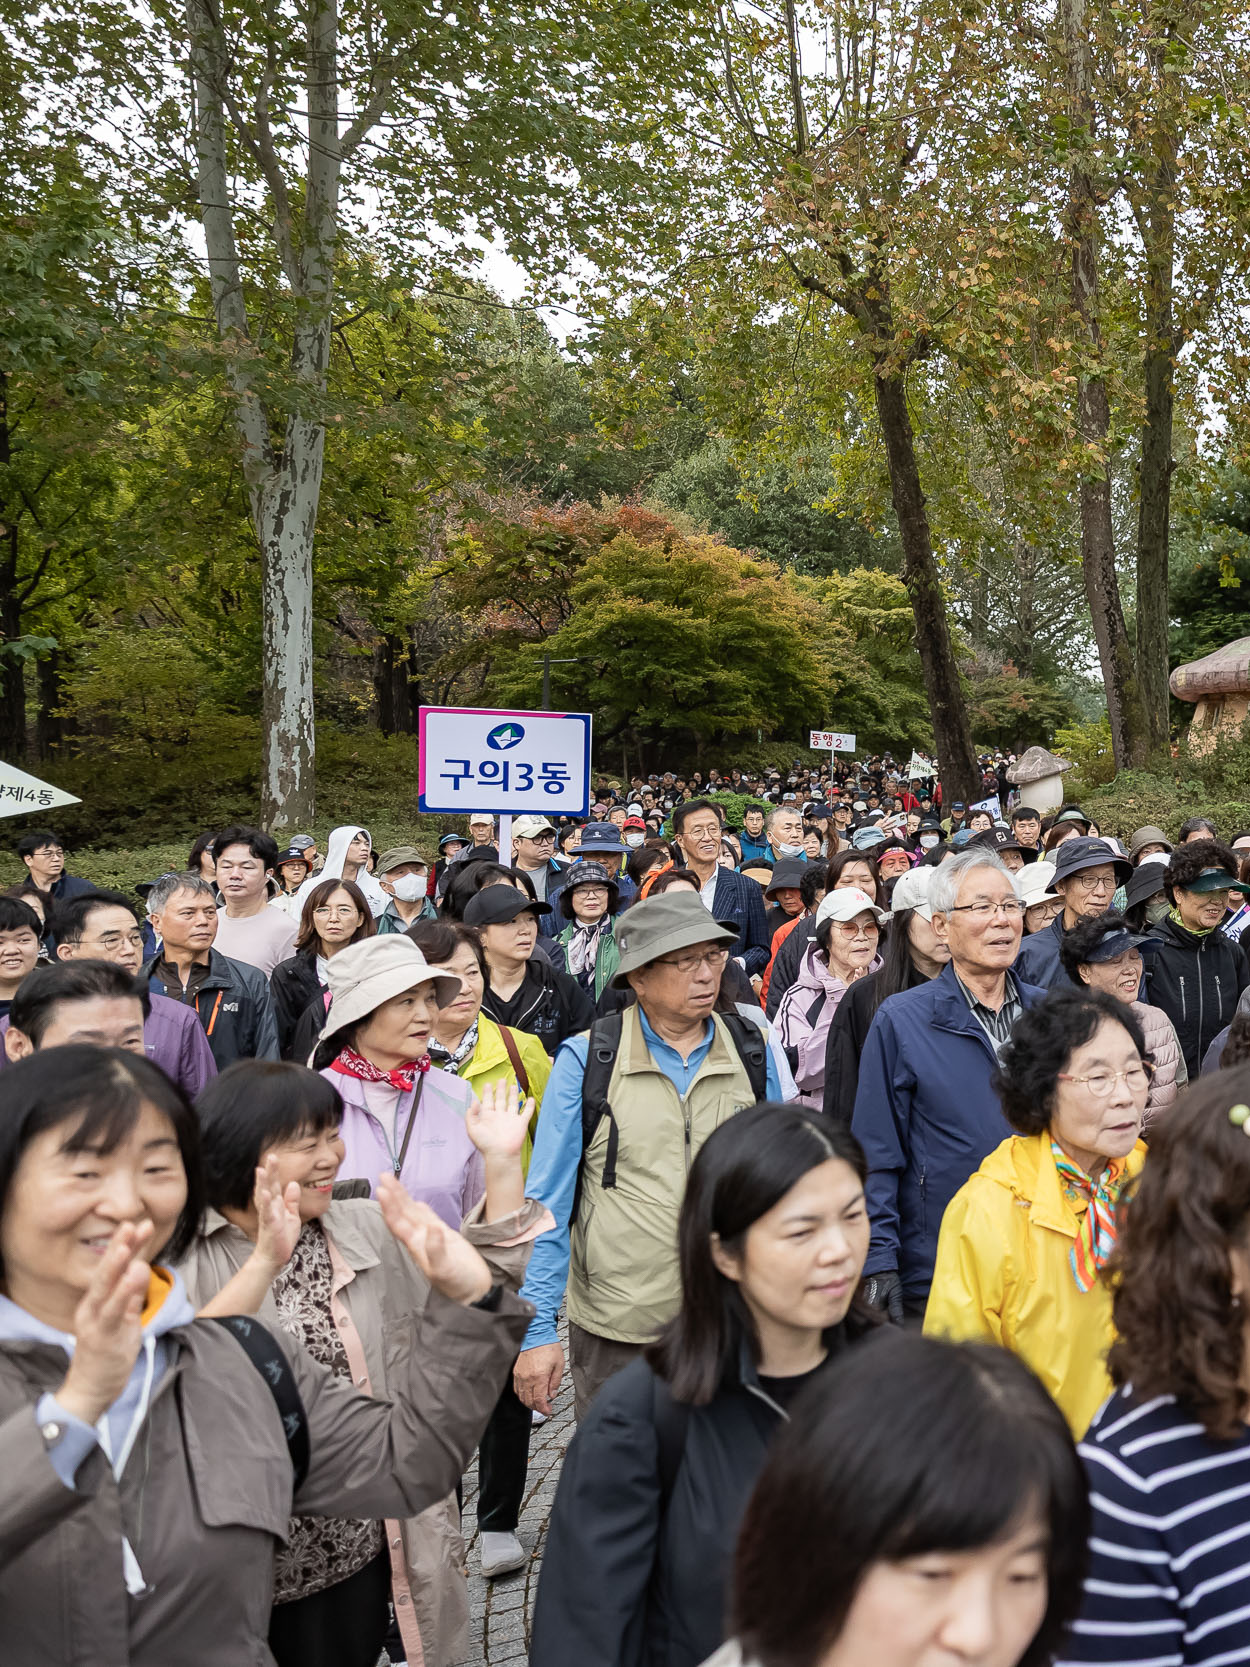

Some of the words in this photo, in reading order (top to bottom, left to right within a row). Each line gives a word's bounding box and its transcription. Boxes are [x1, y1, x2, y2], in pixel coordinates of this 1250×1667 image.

[811, 733, 833, 747] 동행
[835, 738, 842, 749] 2
[440, 759, 571, 795] 구의3동
